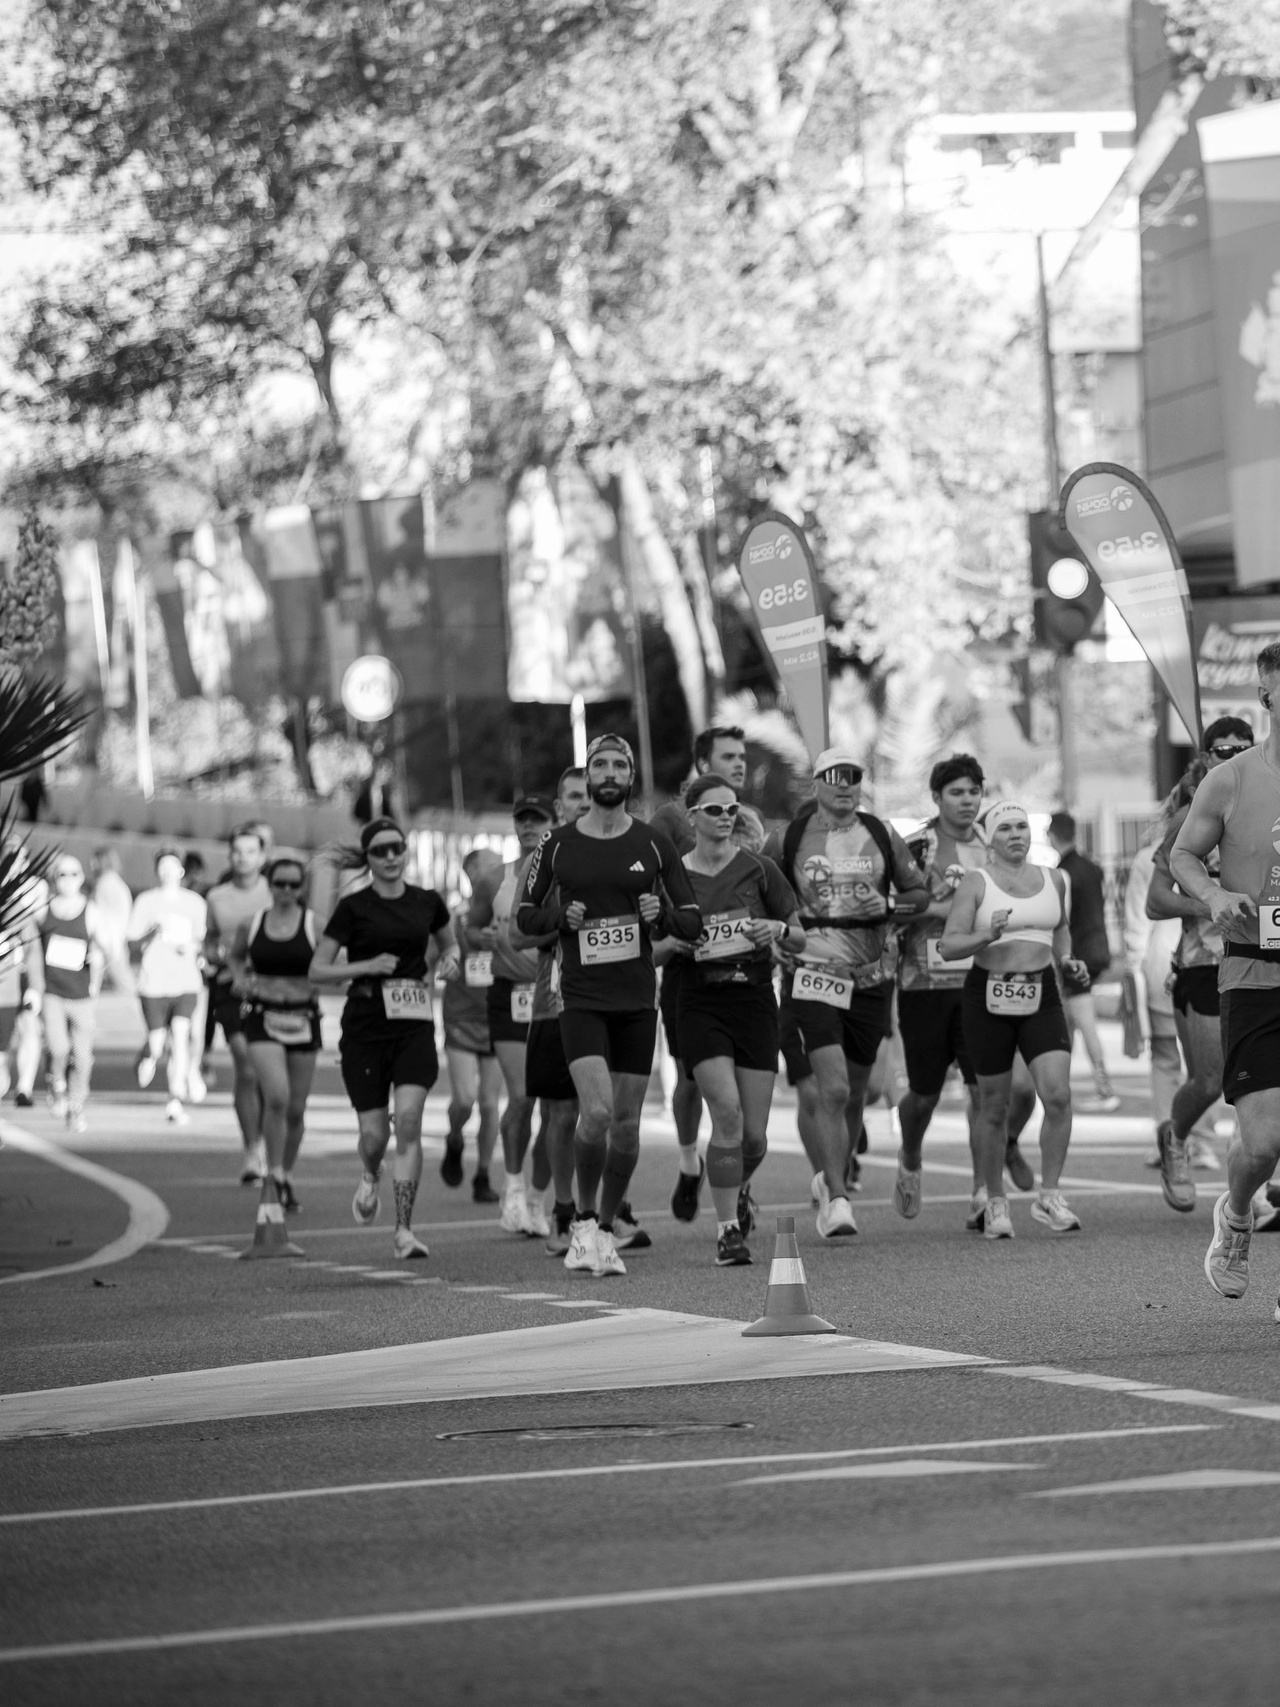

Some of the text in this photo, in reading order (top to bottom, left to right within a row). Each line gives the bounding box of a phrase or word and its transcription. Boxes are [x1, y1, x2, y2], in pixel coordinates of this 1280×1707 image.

[527, 830, 552, 896] ADIZERO
[587, 926, 634, 946] 6335
[704, 921, 745, 943] 794
[801, 974, 846, 995] 6670
[993, 983, 1036, 1000] 6543
